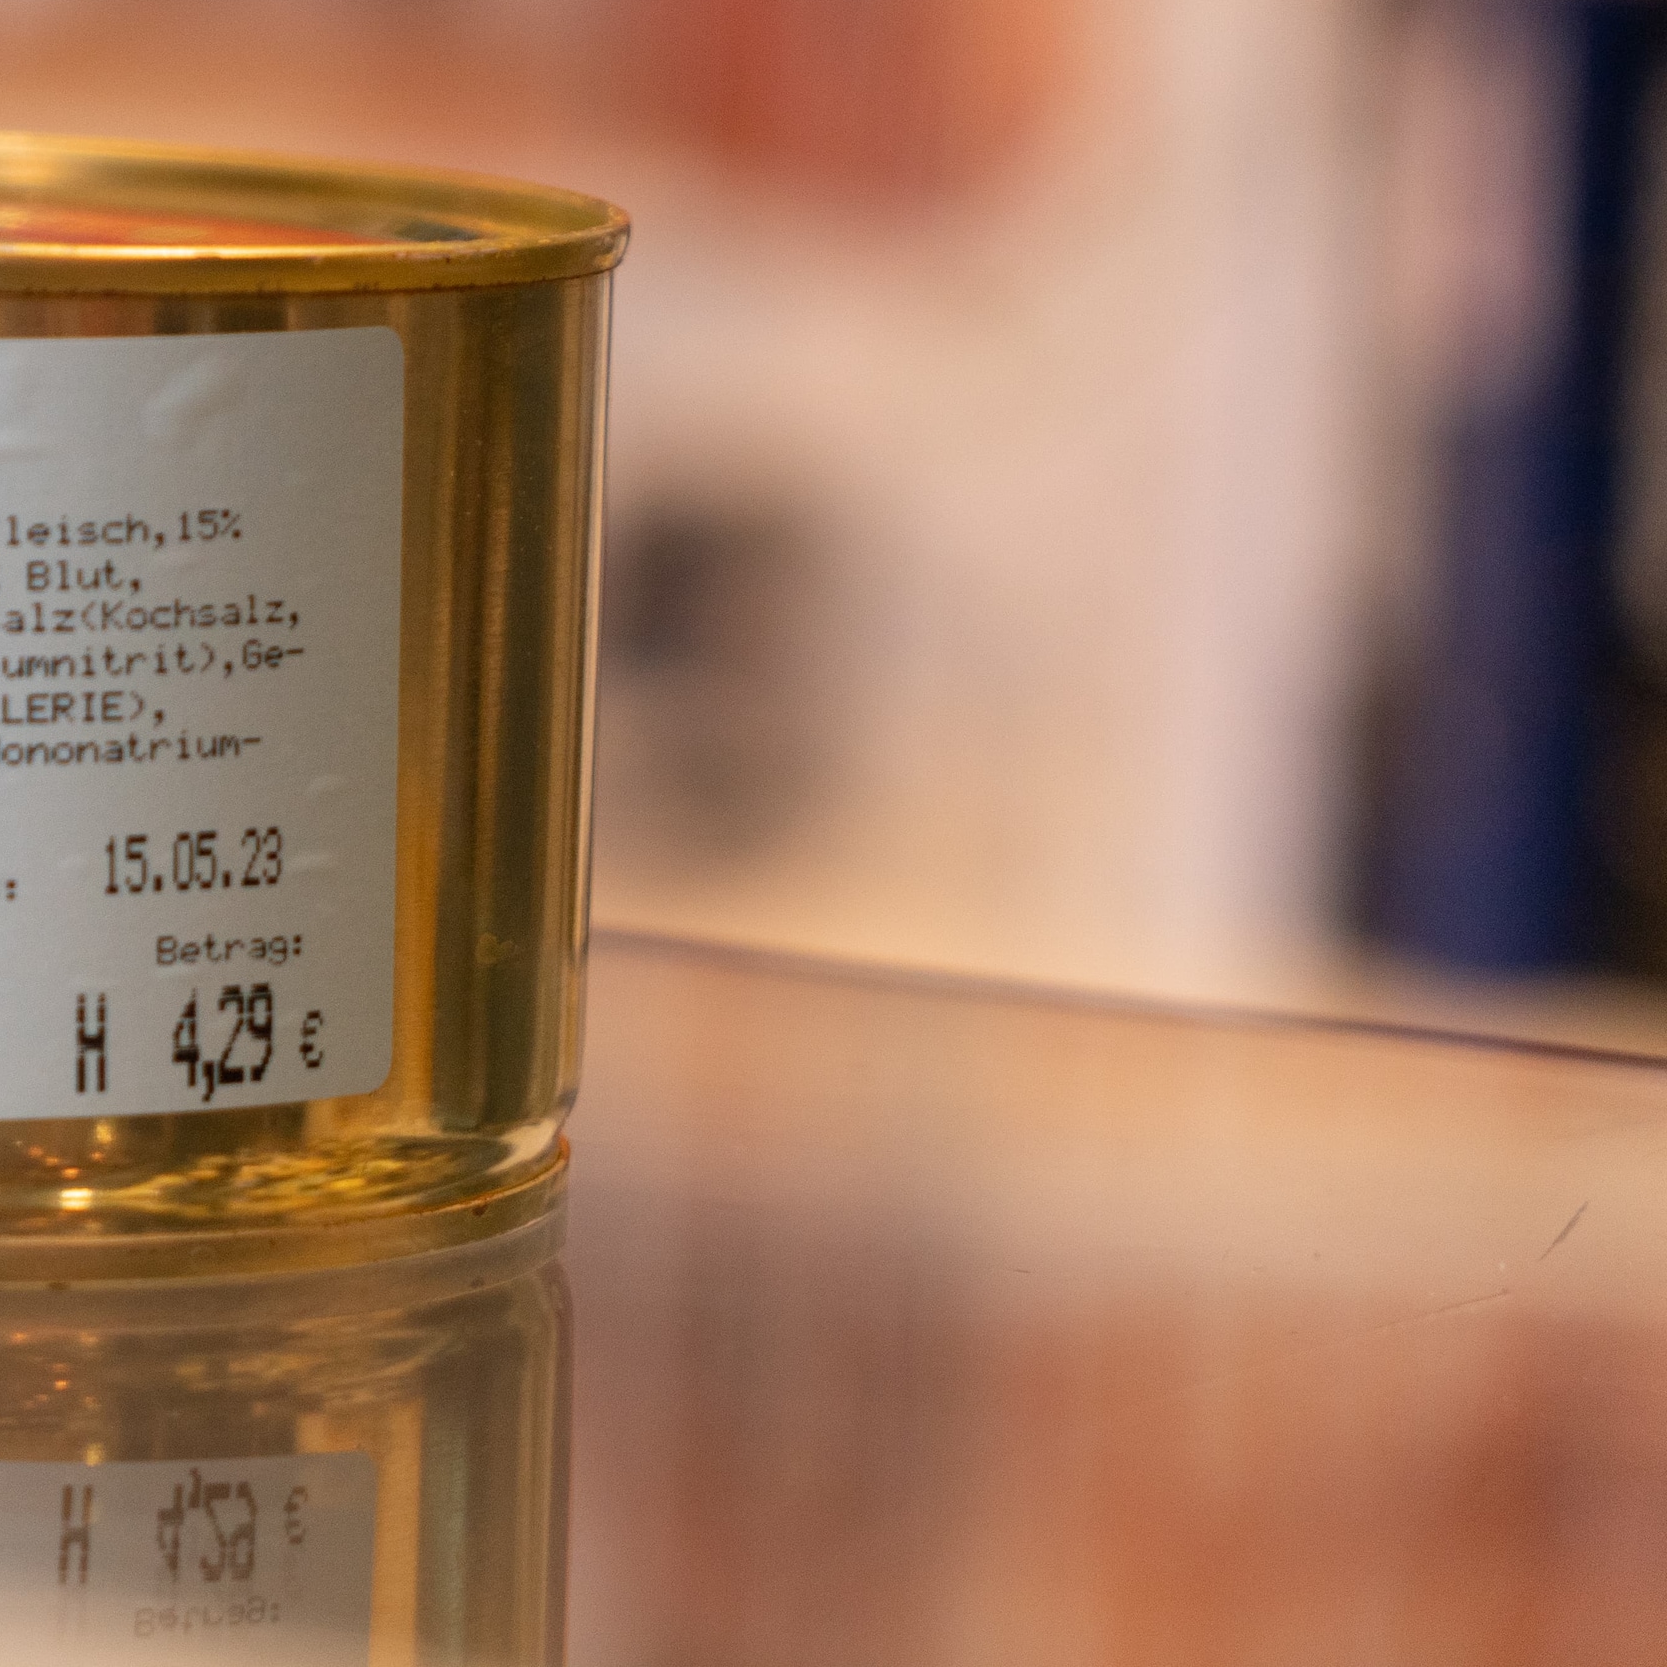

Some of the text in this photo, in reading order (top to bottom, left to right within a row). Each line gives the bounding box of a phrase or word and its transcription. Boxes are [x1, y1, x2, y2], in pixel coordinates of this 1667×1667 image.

[26, 561, 141, 596] Blut,
[105, 827, 283, 895] 15.05.23
[156, 934, 302, 966] Betrag:
[76, 983, 323, 1102] H 4,29 €
